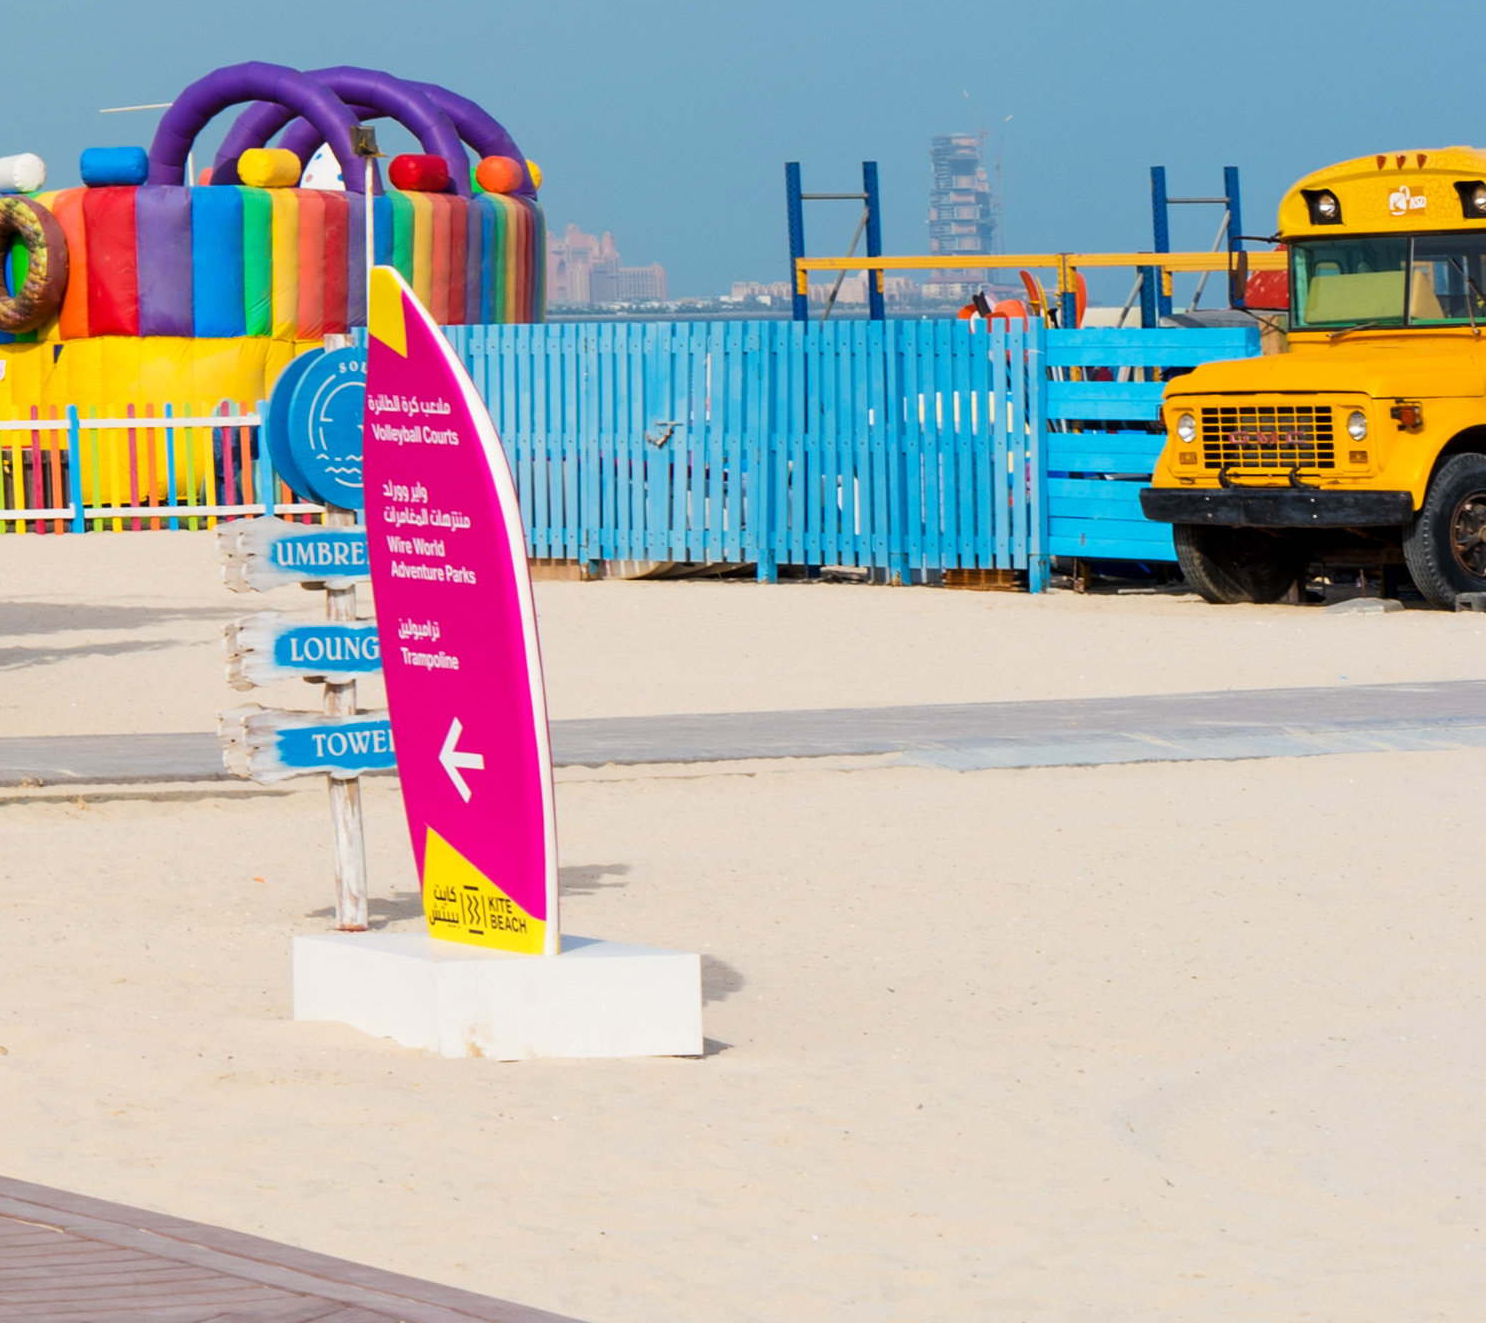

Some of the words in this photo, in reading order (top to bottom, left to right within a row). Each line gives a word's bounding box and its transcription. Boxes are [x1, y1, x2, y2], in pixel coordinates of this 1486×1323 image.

[367, 394, 400, 416] الطائرة
[401, 395, 419, 417] كرة
[371, 423, 422, 446] Volleyball
[423, 425, 460, 446] Courts
[1229, 430, 1307, 445] GMC
[382, 479, 409, 503] وورلد
[410, 481, 428, 504] واير
[383, 506, 428, 527] المغامرات
[386, 535, 412, 554] Wire
[412, 538, 445, 557] World
[391, 560, 445, 581] Adventure
[445, 564, 477, 585] Parks
[398, 618, 441, 642] ترامبولين
[290, 635, 380, 662] LOUNG
[400, 646, 460, 672] Trampoline
[487, 896, 513, 914] KITE
[490, 914, 528, 935] BEACH
